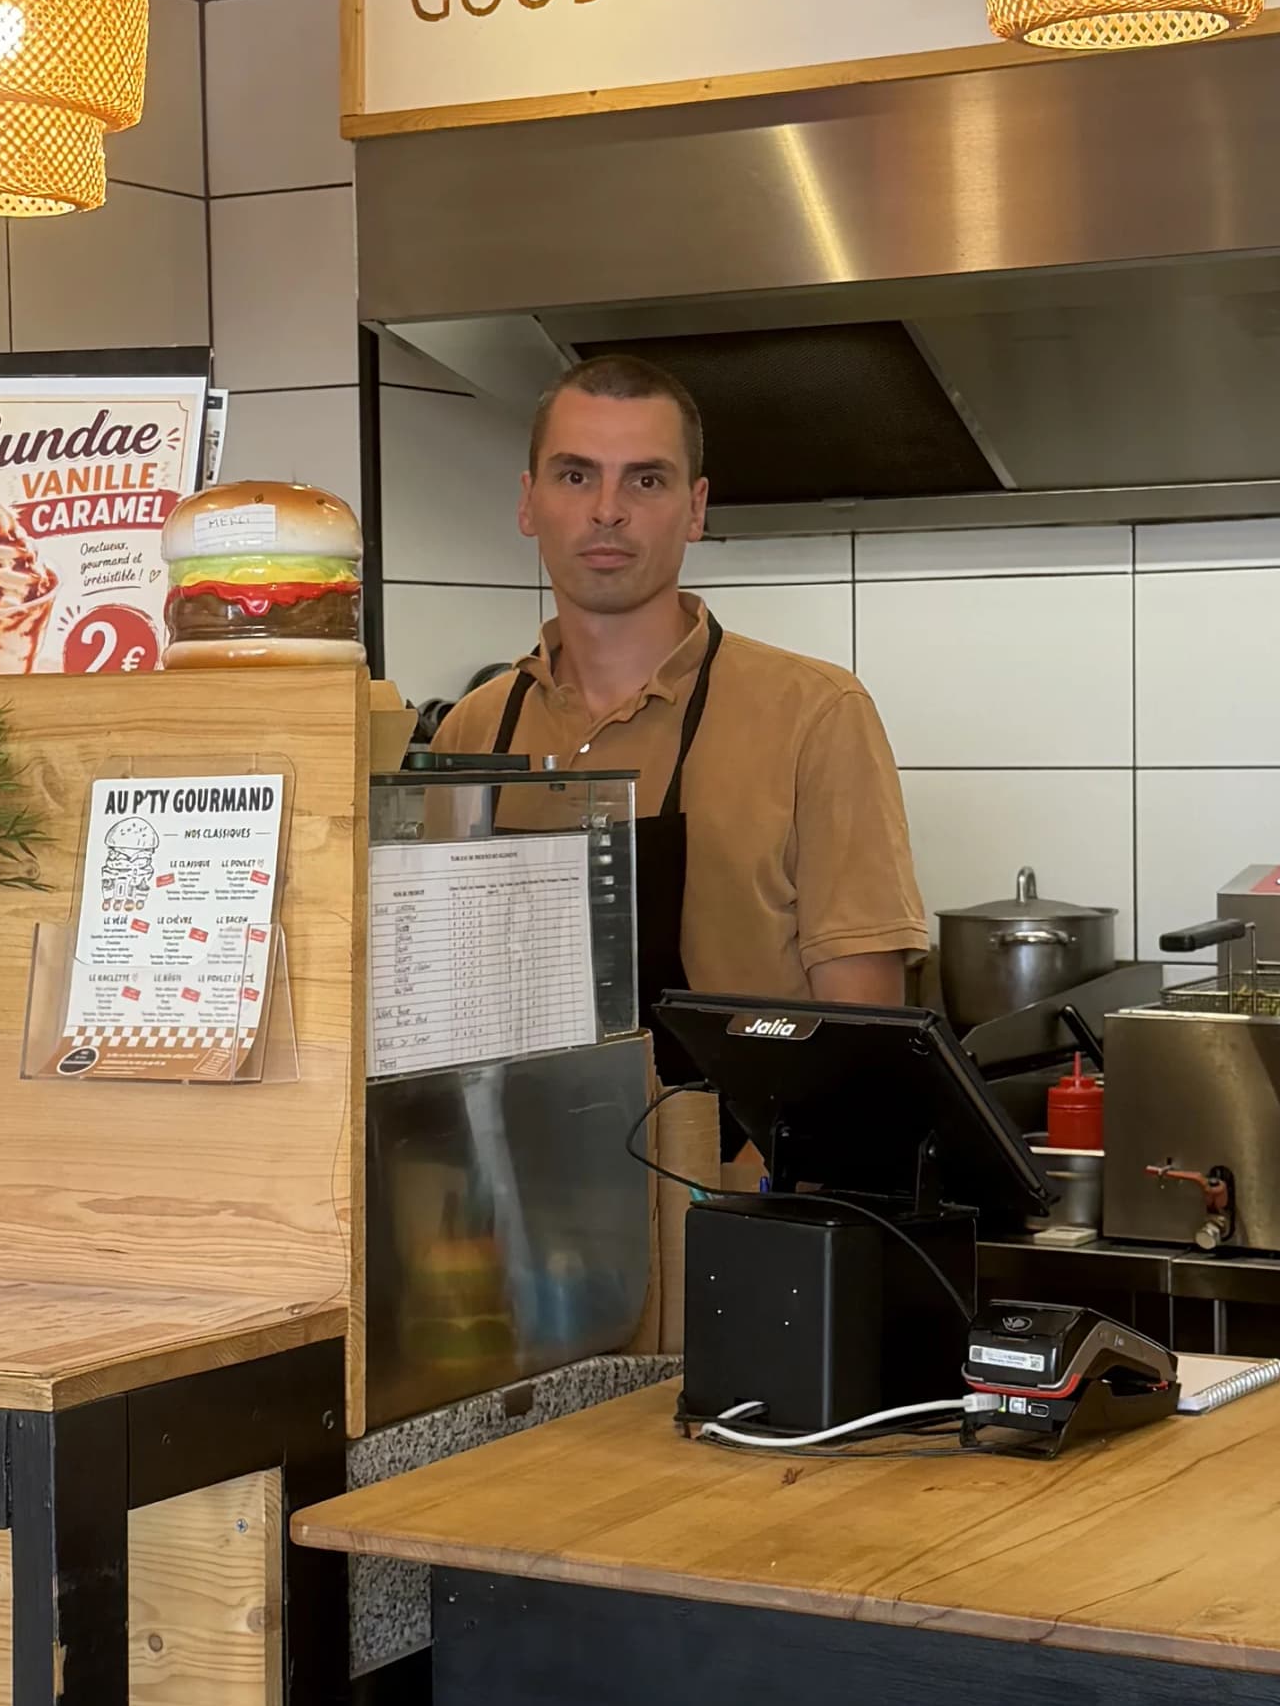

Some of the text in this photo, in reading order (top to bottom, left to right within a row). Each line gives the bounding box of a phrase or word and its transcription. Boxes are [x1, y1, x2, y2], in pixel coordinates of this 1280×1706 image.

[21, 462, 159, 499] VANILLE
[31, 495, 166, 533] CARAMEL
[80, 553, 130, 576] gourmand
[105, 786, 275, 815] AU P'TY GOURMAND
[745, 1017, 797, 1037] Jalia
